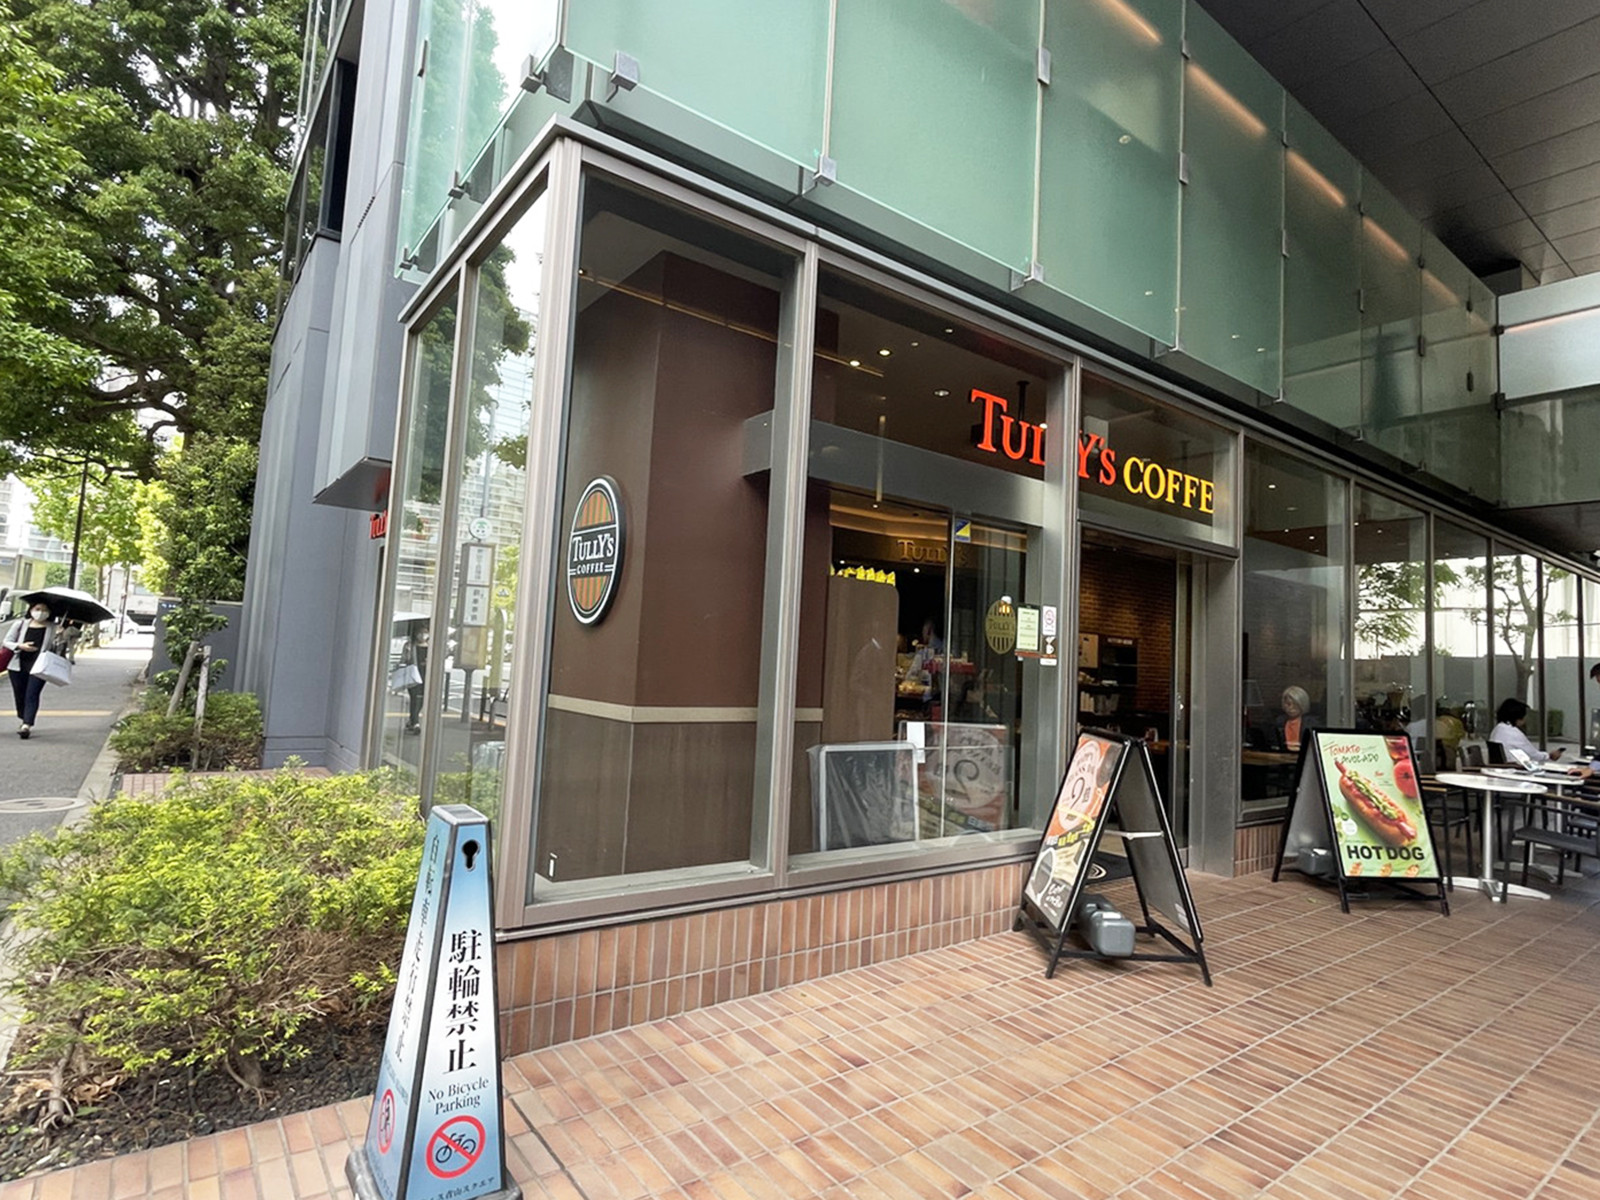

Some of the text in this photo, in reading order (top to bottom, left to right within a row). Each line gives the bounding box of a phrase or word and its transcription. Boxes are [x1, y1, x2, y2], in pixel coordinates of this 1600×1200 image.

[970, 388, 1214, 513] TULY'S COFFE
[571, 532, 614, 562] TULLY'S
[576, 561, 604, 575] COFFEE
[1346, 845, 1425, 860] HOT DOG
[443, 929, 483, 1075] 駐輪禁止
[428, 1076, 490, 1103] No Bicycle
[435, 1093, 481, 1116] Parking
[420, 1176, 496, 1200] ス青山スクエア
